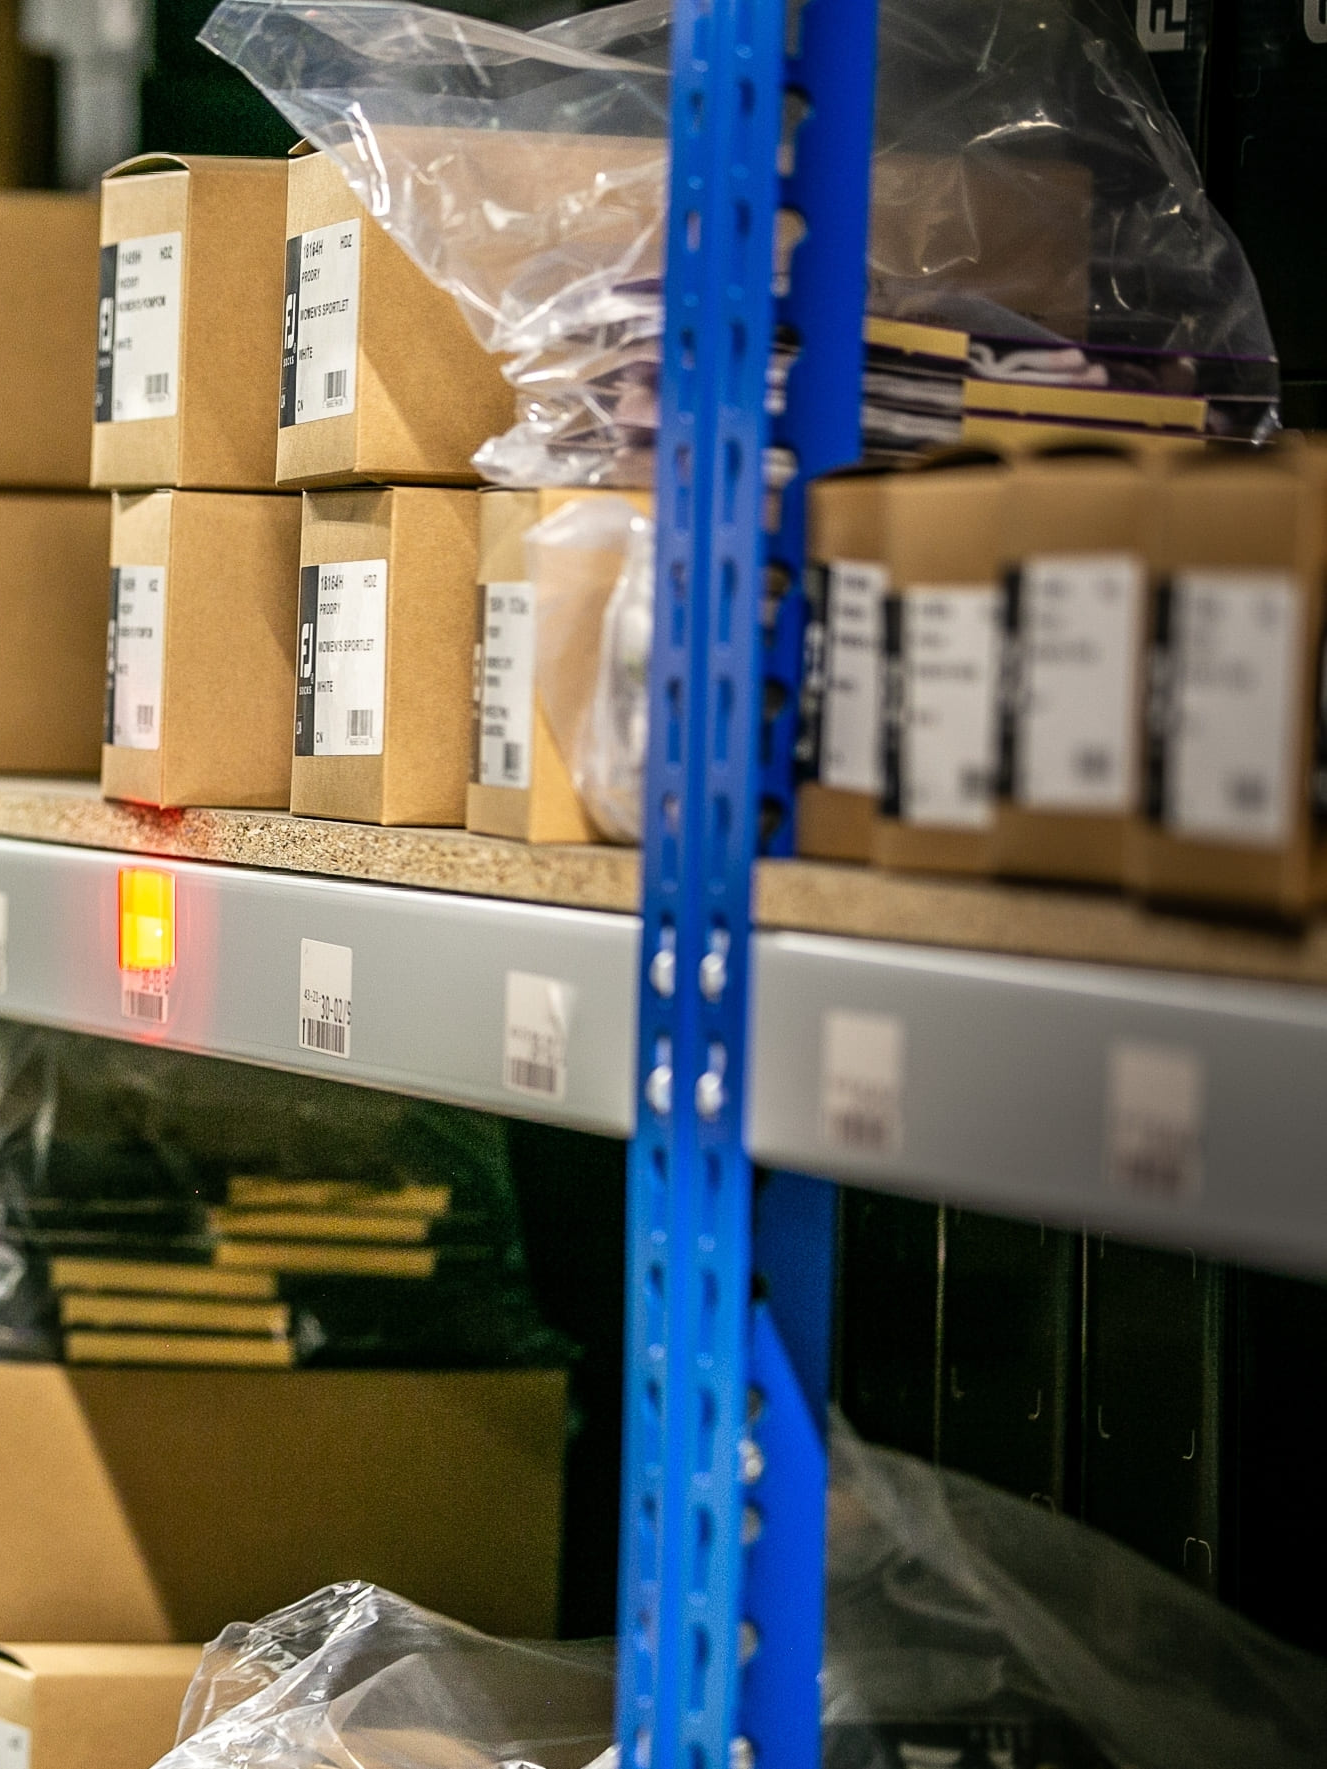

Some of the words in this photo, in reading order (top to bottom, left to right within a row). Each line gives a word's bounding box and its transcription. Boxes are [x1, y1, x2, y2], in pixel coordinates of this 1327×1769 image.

[299, 346, 313, 361] WHITE
[298, 686, 312, 696] SOCKS
[316, 680, 333, 692] WHITE
